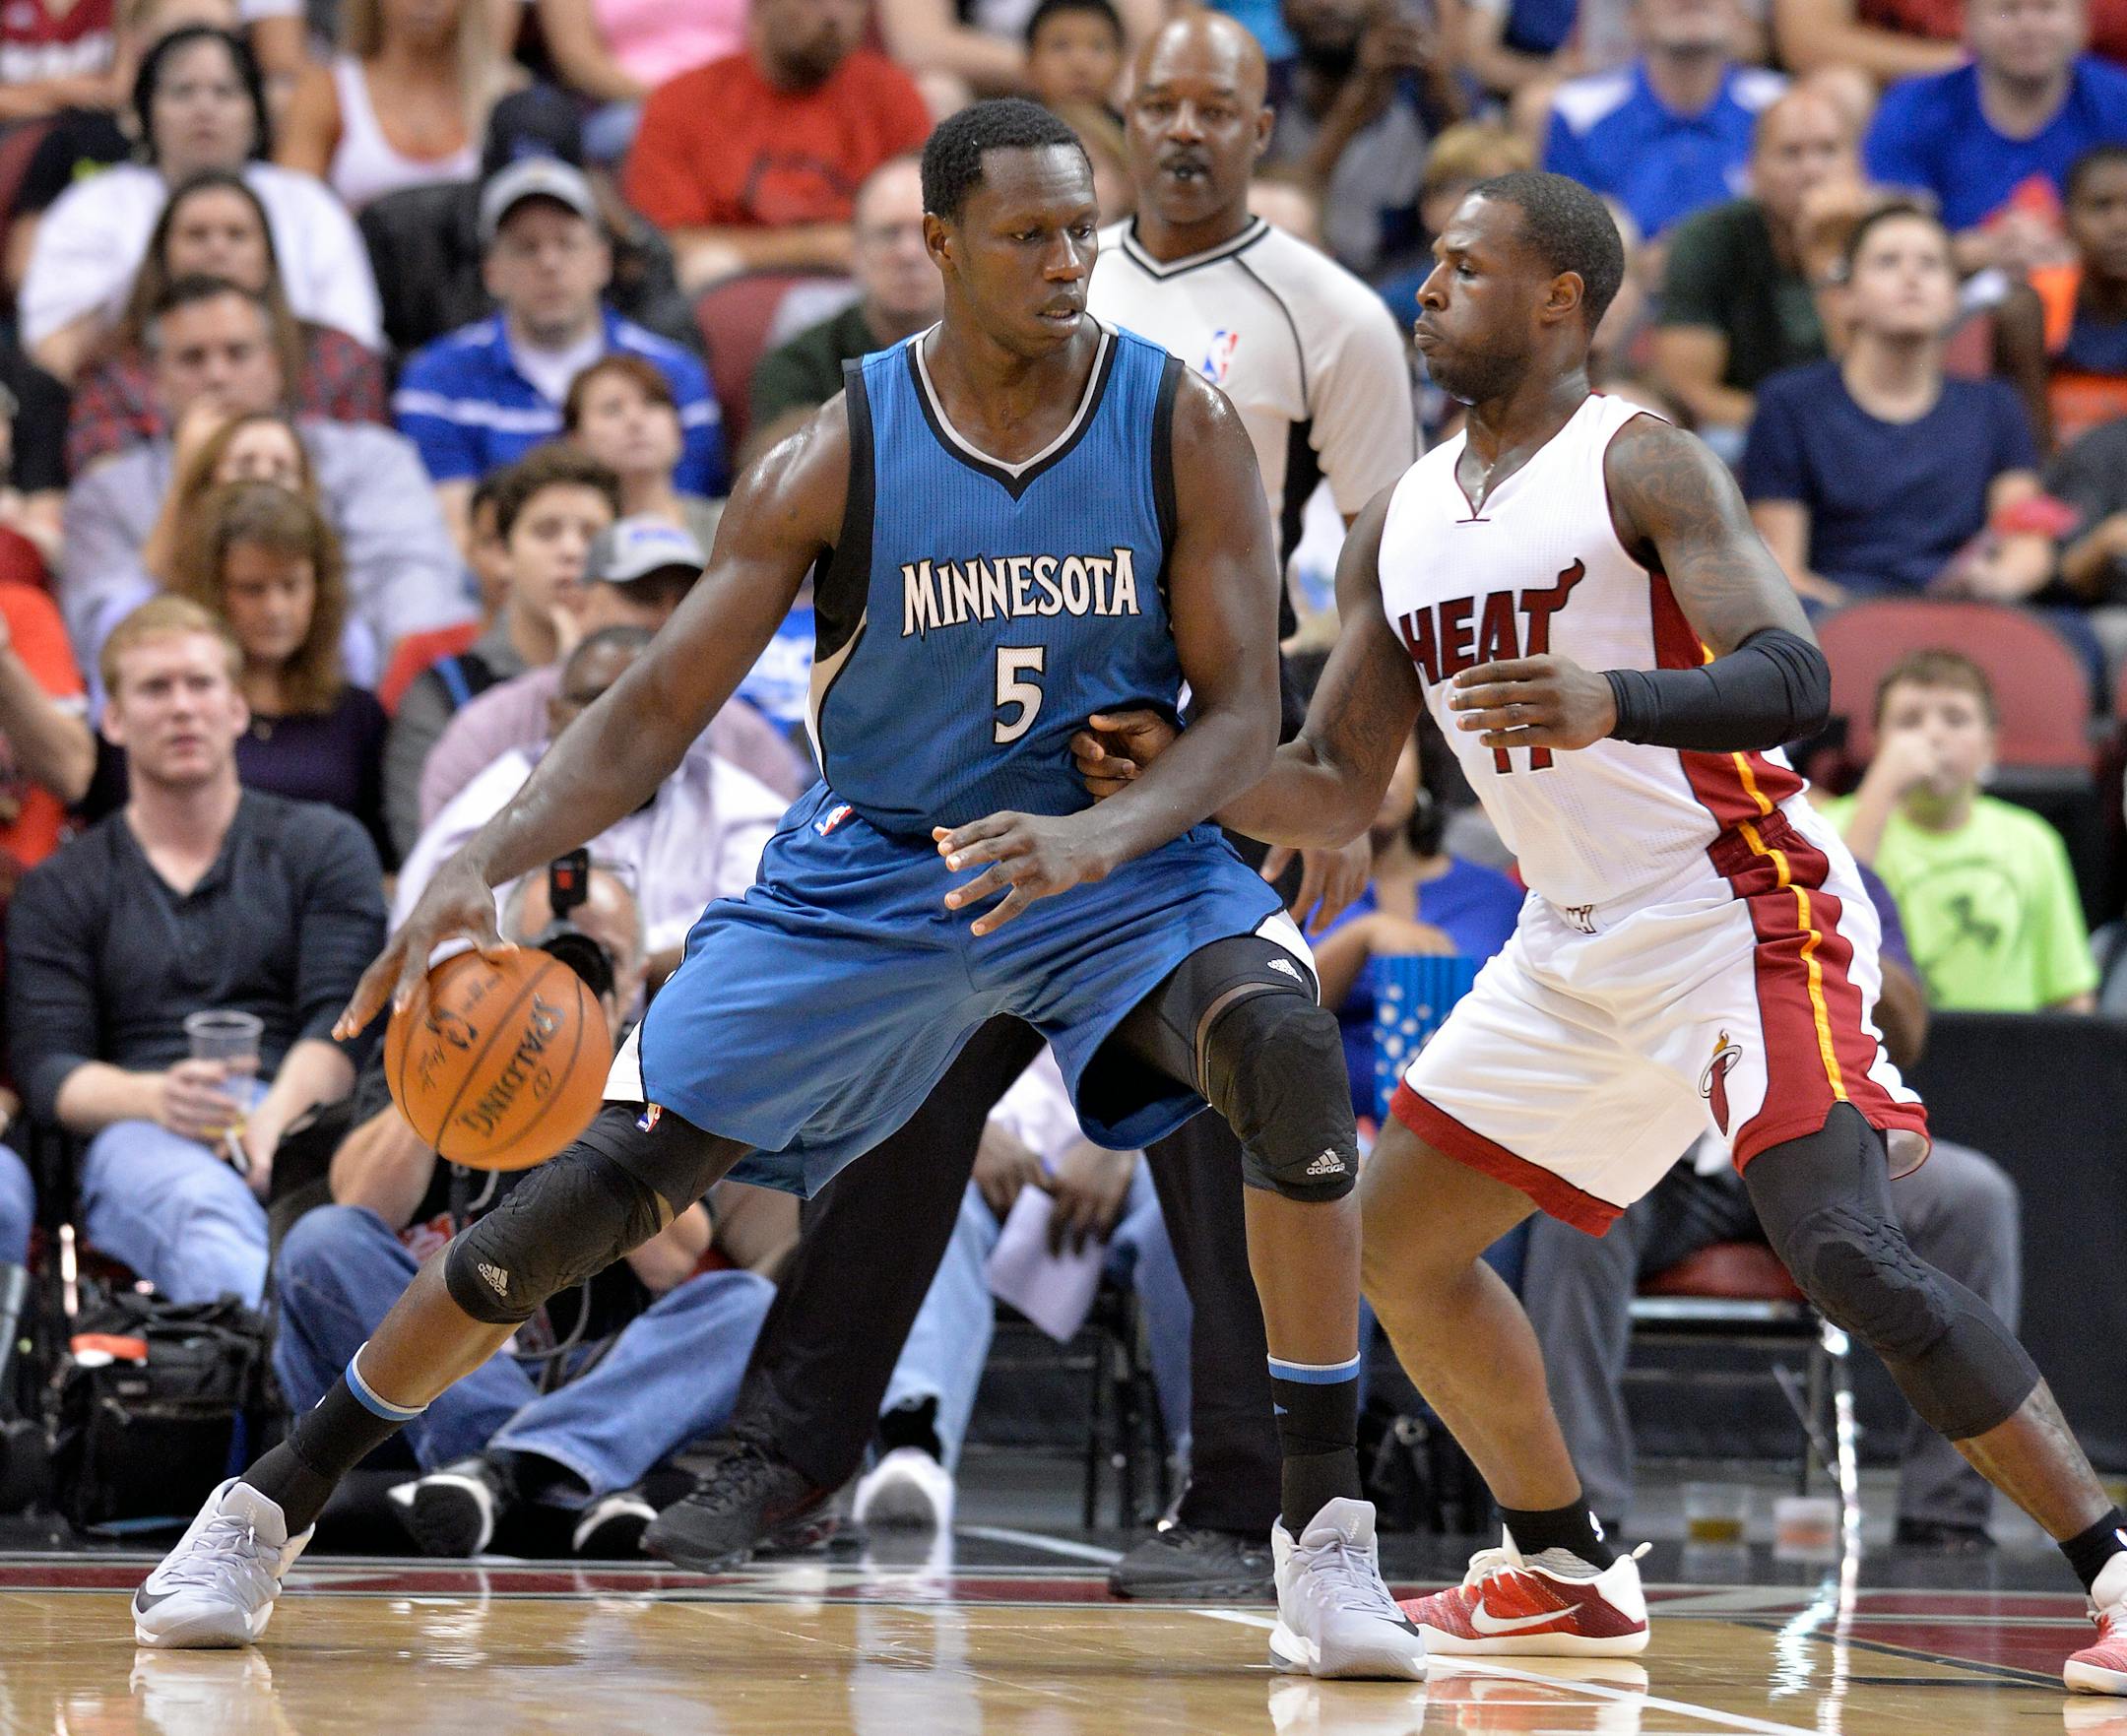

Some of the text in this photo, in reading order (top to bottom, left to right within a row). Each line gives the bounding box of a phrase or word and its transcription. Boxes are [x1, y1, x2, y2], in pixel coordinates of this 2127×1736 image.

[900, 547, 1142, 640] MINNESOTA
[1398, 557, 1585, 686] HEAT
[993, 644, 1048, 744] 5
[453, 993, 564, 1137] SPALDING
[1306, 1162, 1346, 1176] adidas
[478, 1262, 508, 1297] adidas
